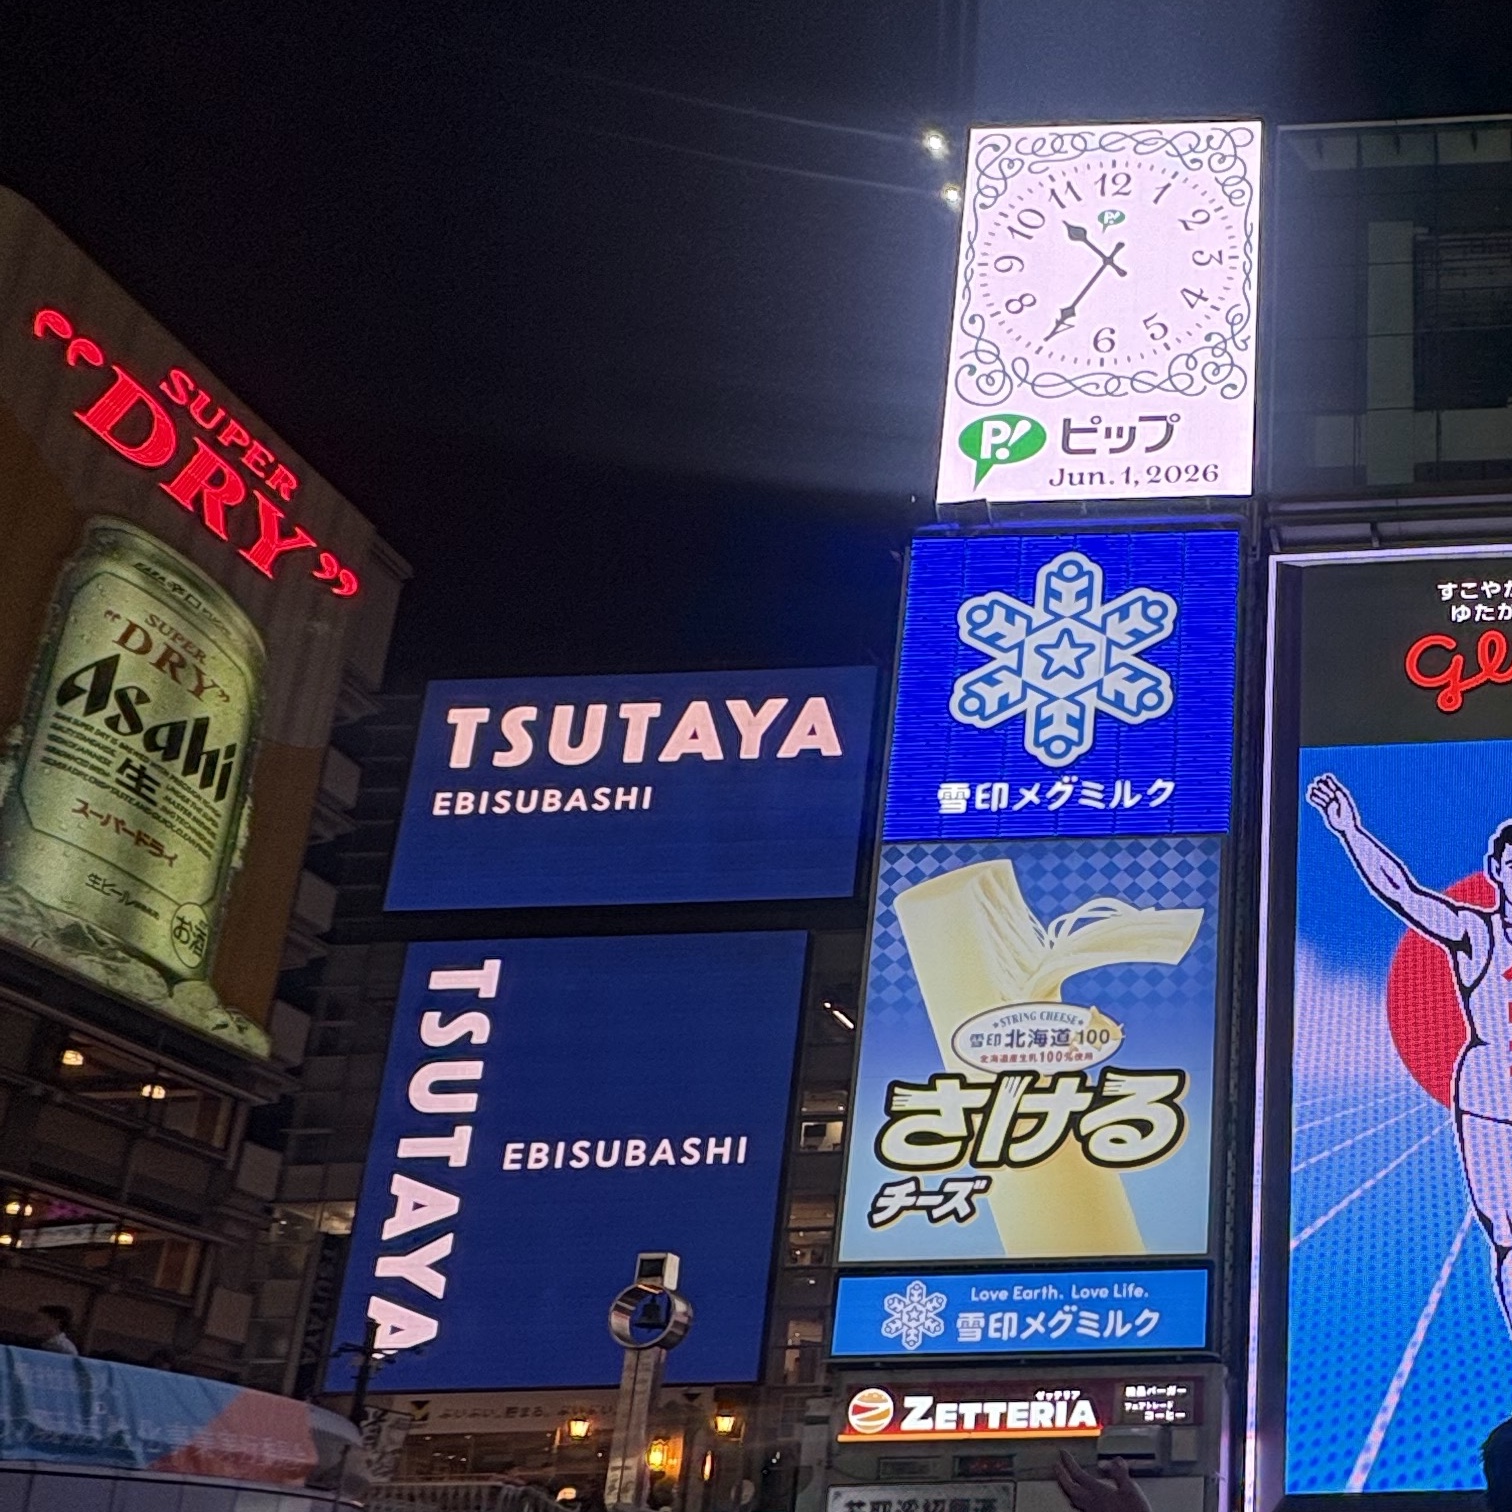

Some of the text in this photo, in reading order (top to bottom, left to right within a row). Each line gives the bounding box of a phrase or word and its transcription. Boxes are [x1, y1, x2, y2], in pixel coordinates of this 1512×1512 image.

[1094, 172, 1132, 197] 12
[160, 369, 298, 500] SUPER
[1062, 413, 1181, 455] ピップ
[1050, 469, 1114, 486] Jun.
[1146, 464, 1219, 483] 2026
[145, 614, 206, 665] SUPER
[56, 654, 236, 803] Asahi
[446, 696, 843, 770] TSUTAYA
[115, 757, 161, 806] 生
[433, 786, 653, 817] EBISUBASHI
[937, 775, 1175, 814] 雪印メグミルク
[72, 798, 178, 868] スーパードライ
[1000, 1011, 1078, 1028] STRING CHEESE
[875, 1067, 1186, 1170] さける
[367, 959, 501, 1358] TSUTAYA
[502, 1136, 748, 1171] EBISUBASHI
[868, 1176, 993, 1228] チーズ
[971, 1283, 1149, 1301] Love Earth. Love Life.
[956, 1305, 1160, 1343] 雪印メグミルク
[900, 1395, 1098, 1430] ZETTERIA
[1144, 1410, 1186, 1421] コーヒー
